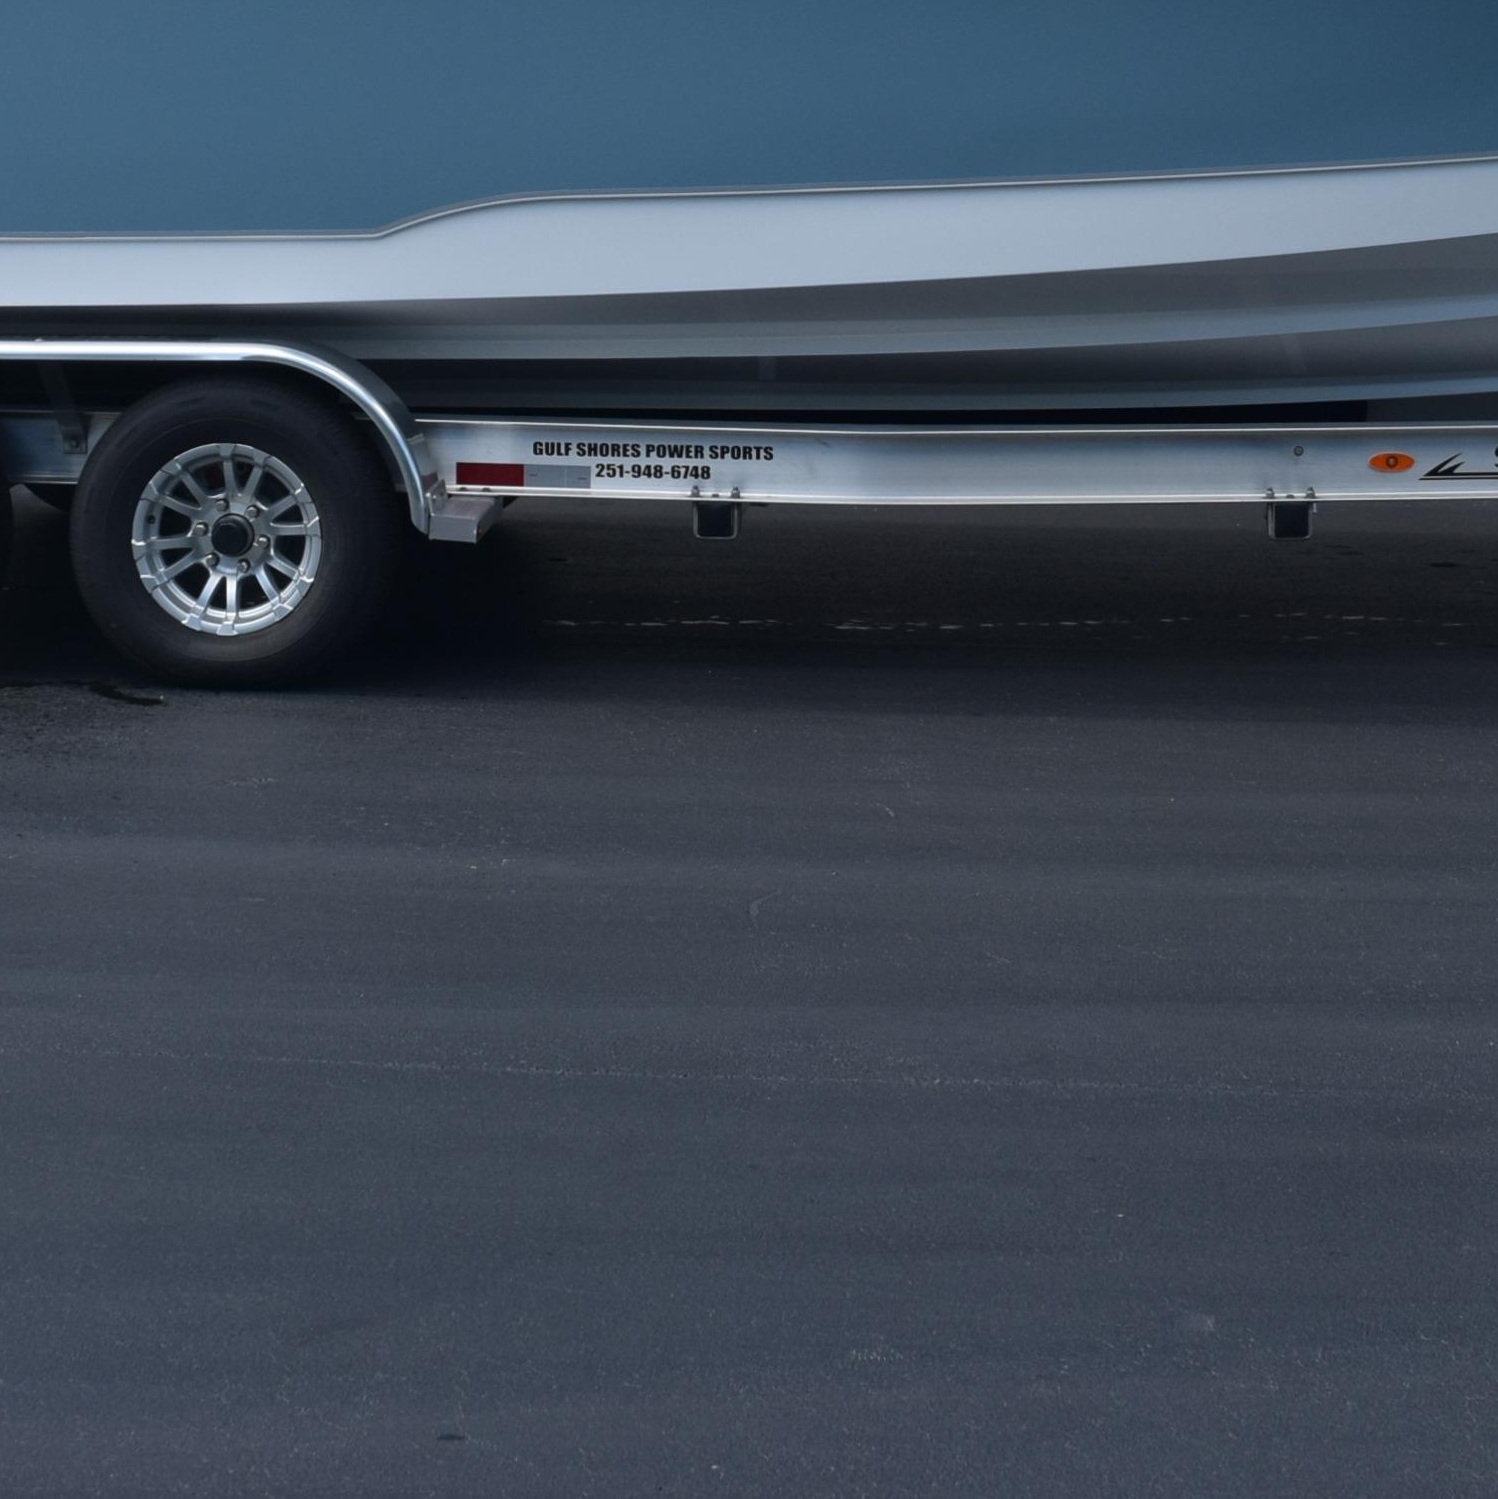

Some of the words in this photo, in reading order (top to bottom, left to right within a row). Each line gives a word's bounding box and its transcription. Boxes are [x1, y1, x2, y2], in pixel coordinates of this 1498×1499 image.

[532, 441, 573, 457] GULF
[576, 442, 641, 459] SHORES
[645, 443, 704, 460] POWER
[708, 445, 774, 461] SPORTS
[595, 463, 711, 480] 251-948-6748
